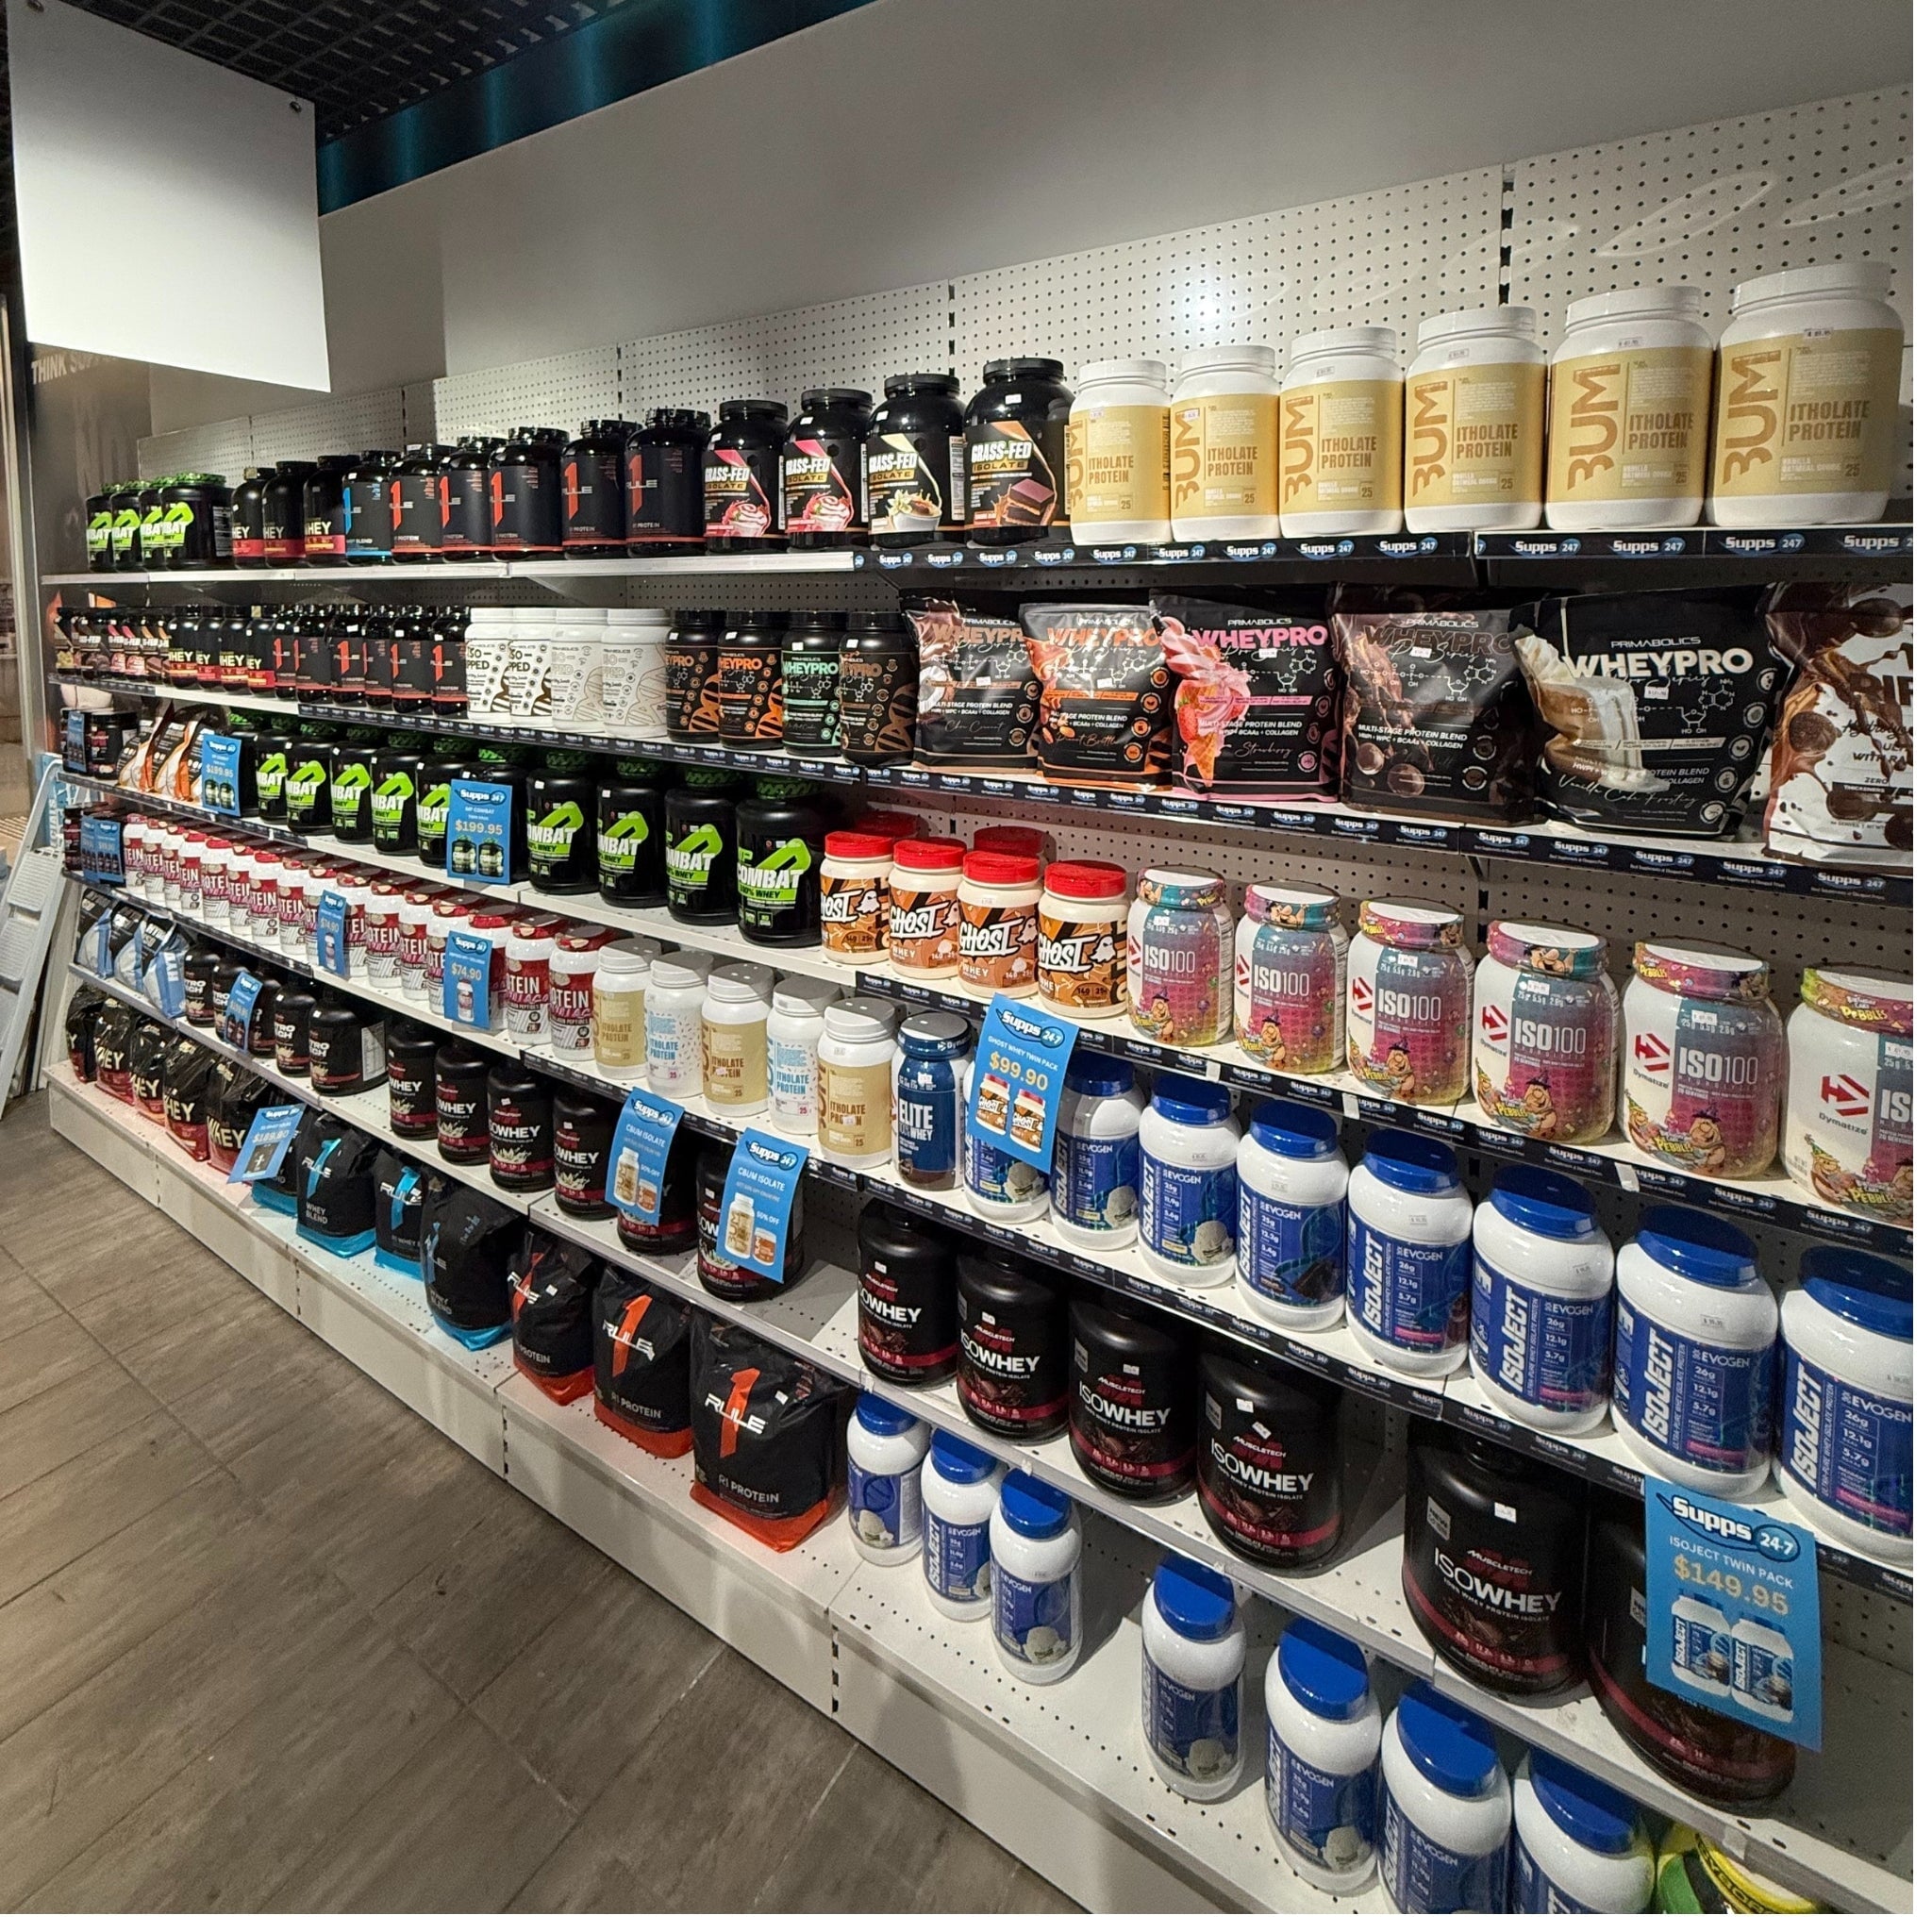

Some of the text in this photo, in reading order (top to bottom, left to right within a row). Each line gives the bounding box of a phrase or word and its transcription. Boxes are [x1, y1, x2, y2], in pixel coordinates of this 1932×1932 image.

[31, 360, 67, 384] THINK
[1790, 400, 1871, 422] ITHOLATE
[1629, 412, 1694, 432] ITHOLATE
[1789, 421, 1862, 441] PROTEIN
[1457, 424, 1519, 442] ITHOLATE
[1628, 430, 1688, 450] PROTEIN
[971, 440, 1033, 461] GRASS-FED
[1322, 436, 1377, 452] ITHOLATE
[1457, 441, 1512, 459] PROTEIN
[1208, 446, 1258, 461] ITHOLATE
[1322, 451, 1372, 469] PROTEIN
[1088, 456, 1134, 470] ITHOLATE
[1208, 461, 1254, 477] PROTEIN
[1089, 471, 1129, 485] PROTEIN
[1300, 543, 1352, 556] Supps 247
[1379, 541, 1436, 554] Supps 247
[1515, 541, 1578, 554] Supps 247
[1613, 541, 1683, 554] Supps 247
[1725, 537, 1802, 550] Supps 247
[1843, 535, 1899, 549] Supps
[1226, 545, 1258, 558] Supps
[1227, 618, 1292, 626] PRIMABOLICS
[1406, 619, 1478, 628] PRIMABOLICS
[1191, 625, 1327, 649] WHEYPRO
[1611, 637, 1701, 648] PRIMABOLICS
[1562, 648, 1754, 678] WHEYPRO
[1244, 721, 1302, 729] PROTEIN BLEND
[1679, 767, 1710, 776] BLEND
[1864, 776, 1888, 785] ZERO
[460, 789, 490, 800] Supps
[455, 819, 503, 835] $199.95
[1635, 851, 1692, 865] Supps 247
[1723, 860, 1785, 877] Supps 247
[1817, 872, 1884, 890] Supps 247
[890, 901, 949, 938] GHOST
[959, 916, 1024, 957] GHOST
[1145, 944, 1195, 973] ISO100
[451, 962, 482, 980] $74.90
[961, 966, 989, 977] WHEY
[1254, 964, 1309, 997] ISO100
[1378, 988, 1441, 1022] ISO100
[1840, 1005, 1888, 1022] PEBBLES
[1002, 1010, 1042, 1037] Supps
[1514, 1017, 1586, 1054] ISO100
[650, 1049, 676, 1060] PROTEIN
[712, 1056, 744, 1068] ITHOLATE
[988, 1036, 1058, 1072] GHOST WHEY TWIN PACK
[990, 1051, 1049, 1091] $99.90
[1679, 1046, 1758, 1085] ISO100
[776, 1072, 809, 1084] ITHOLATE
[776, 1082, 806, 1094] PROTEIN
[830, 1101, 866, 1115] ITHOLATE
[899, 1099, 934, 1129] ELITE
[1819, 1111, 1869, 1137] Dymatize
[642, 1131, 665, 1148] ISOLATE
[910, 1129, 933, 1141] WHEY
[738, 1166, 758, 1179] CBUM
[758, 1174, 786, 1192] ISOLATE
[1167, 1172, 1202, 1185] EVOGEN
[380, 1182, 422, 1206] RULE
[1142, 1156, 1156, 1244] ISOJECT
[306, 1211, 328, 1224] BLEND
[307, 1202, 326, 1215] WHEY
[1264, 1204, 1301, 1221] EVOGEN
[1240, 1185, 1252, 1278] ISOJECT
[1404, 1248, 1442, 1261] EVOGEN
[1398, 1260, 1416, 1274] 26g
[1362, 1231, 1383, 1331] ISOJECT
[1398, 1276, 1418, 1290] 12.1g
[1398, 1292, 1416, 1305] 5.7g
[1553, 1304, 1593, 1316] EVOGEN
[1547, 1317, 1565, 1329] 26g
[603, 1320, 655, 1360] RULE
[974, 1324, 1015, 1342] MUSCLETECH
[1499, 1284, 1528, 1392] ISOJECT
[1546, 1333, 1567, 1346] 12.1g
[519, 1344, 551, 1364] PROTEIN
[960, 1328, 1041, 1373] ISOWHEY
[1545, 1350, 1565, 1363] 5.7g
[1701, 1351, 1750, 1368] EVOGEN
[1695, 1366, 1715, 1379] 26g
[1098, 1376, 1145, 1394] MUSCLETECH
[1641, 1326, 1674, 1444] ISOJECT
[1693, 1383, 1718, 1398] 12.1g
[621, 1398, 661, 1419] PROTEIN
[1079, 1380, 1171, 1427] ISOWHEY
[1692, 1401, 1716, 1416] 5.7g
[1852, 1395, 1912, 1423] EVOGEN
[705, 1392, 768, 1434] RULE
[1844, 1408, 1869, 1427] 26g
[1790, 1362, 1822, 1489] ISOJECT
[1233, 1435, 1286, 1458] MUSCLETECH
[1843, 1427, 1872, 1449] 12.1g
[1210, 1438, 1314, 1492] ISOWHEY
[1842, 1448, 1870, 1468] 5.7g
[731, 1480, 779, 1504] PROTEIN
[1673, 1495, 1752, 1541] Supps
[929, 1521, 941, 1591] ISOJECT
[1467, 1550, 1533, 1576] MUSCLETECH
[1669, 1534, 1794, 1589] ISOJECT TWIN PACK
[1434, 1547, 1562, 1614] ISOWHEY
[1674, 1553, 1789, 1617] $149.95
[1735, 1641, 1747, 1690] ISOJECT
